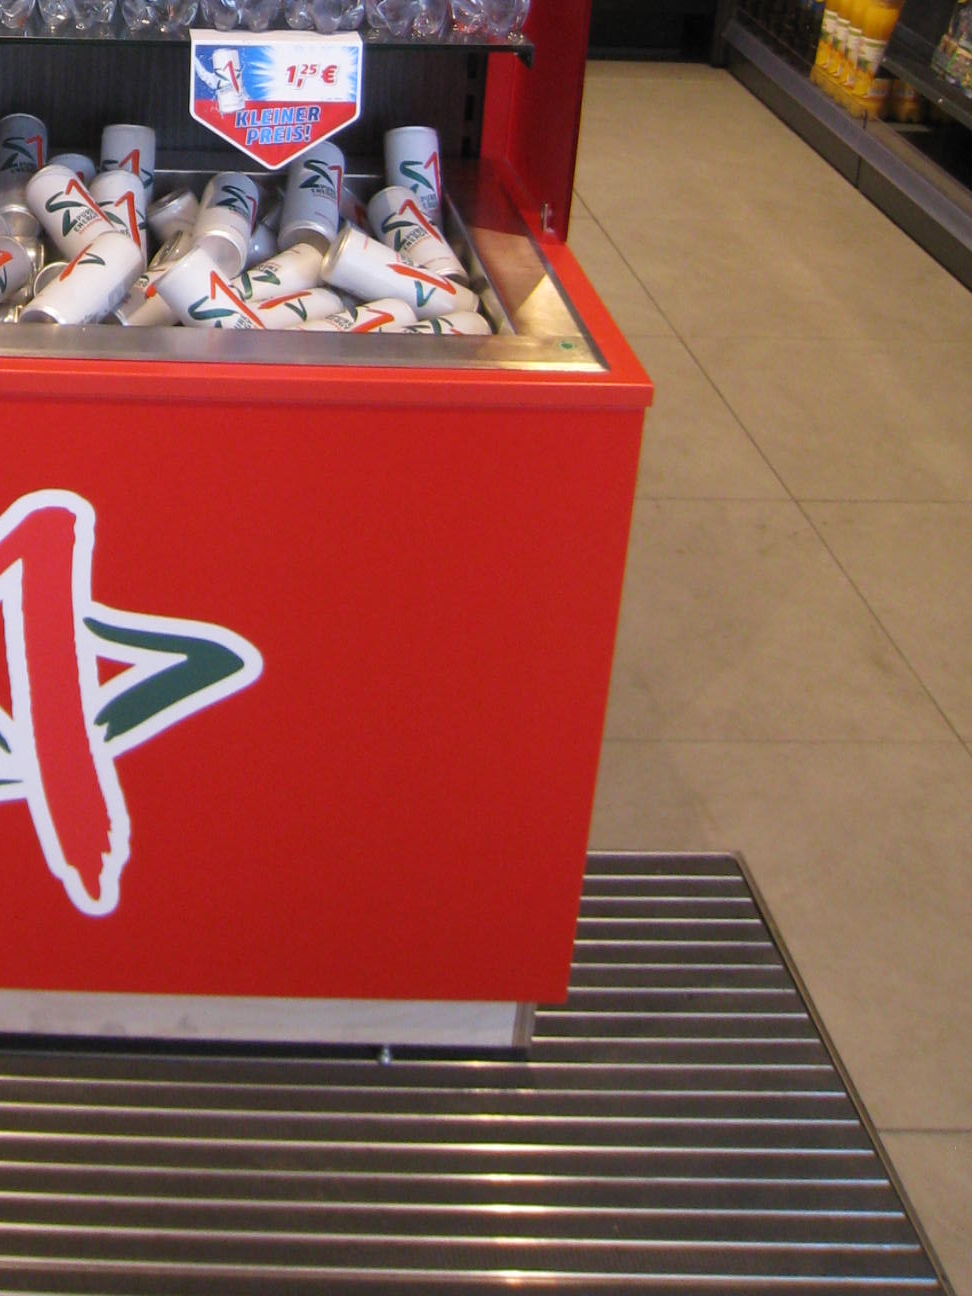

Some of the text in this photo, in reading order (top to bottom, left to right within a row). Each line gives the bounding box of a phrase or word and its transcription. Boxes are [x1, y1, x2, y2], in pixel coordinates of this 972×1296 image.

[321, 64, 338, 84] €
[234, 106, 321, 128] KLEINER
[245, 125, 312, 146] PREIS!
